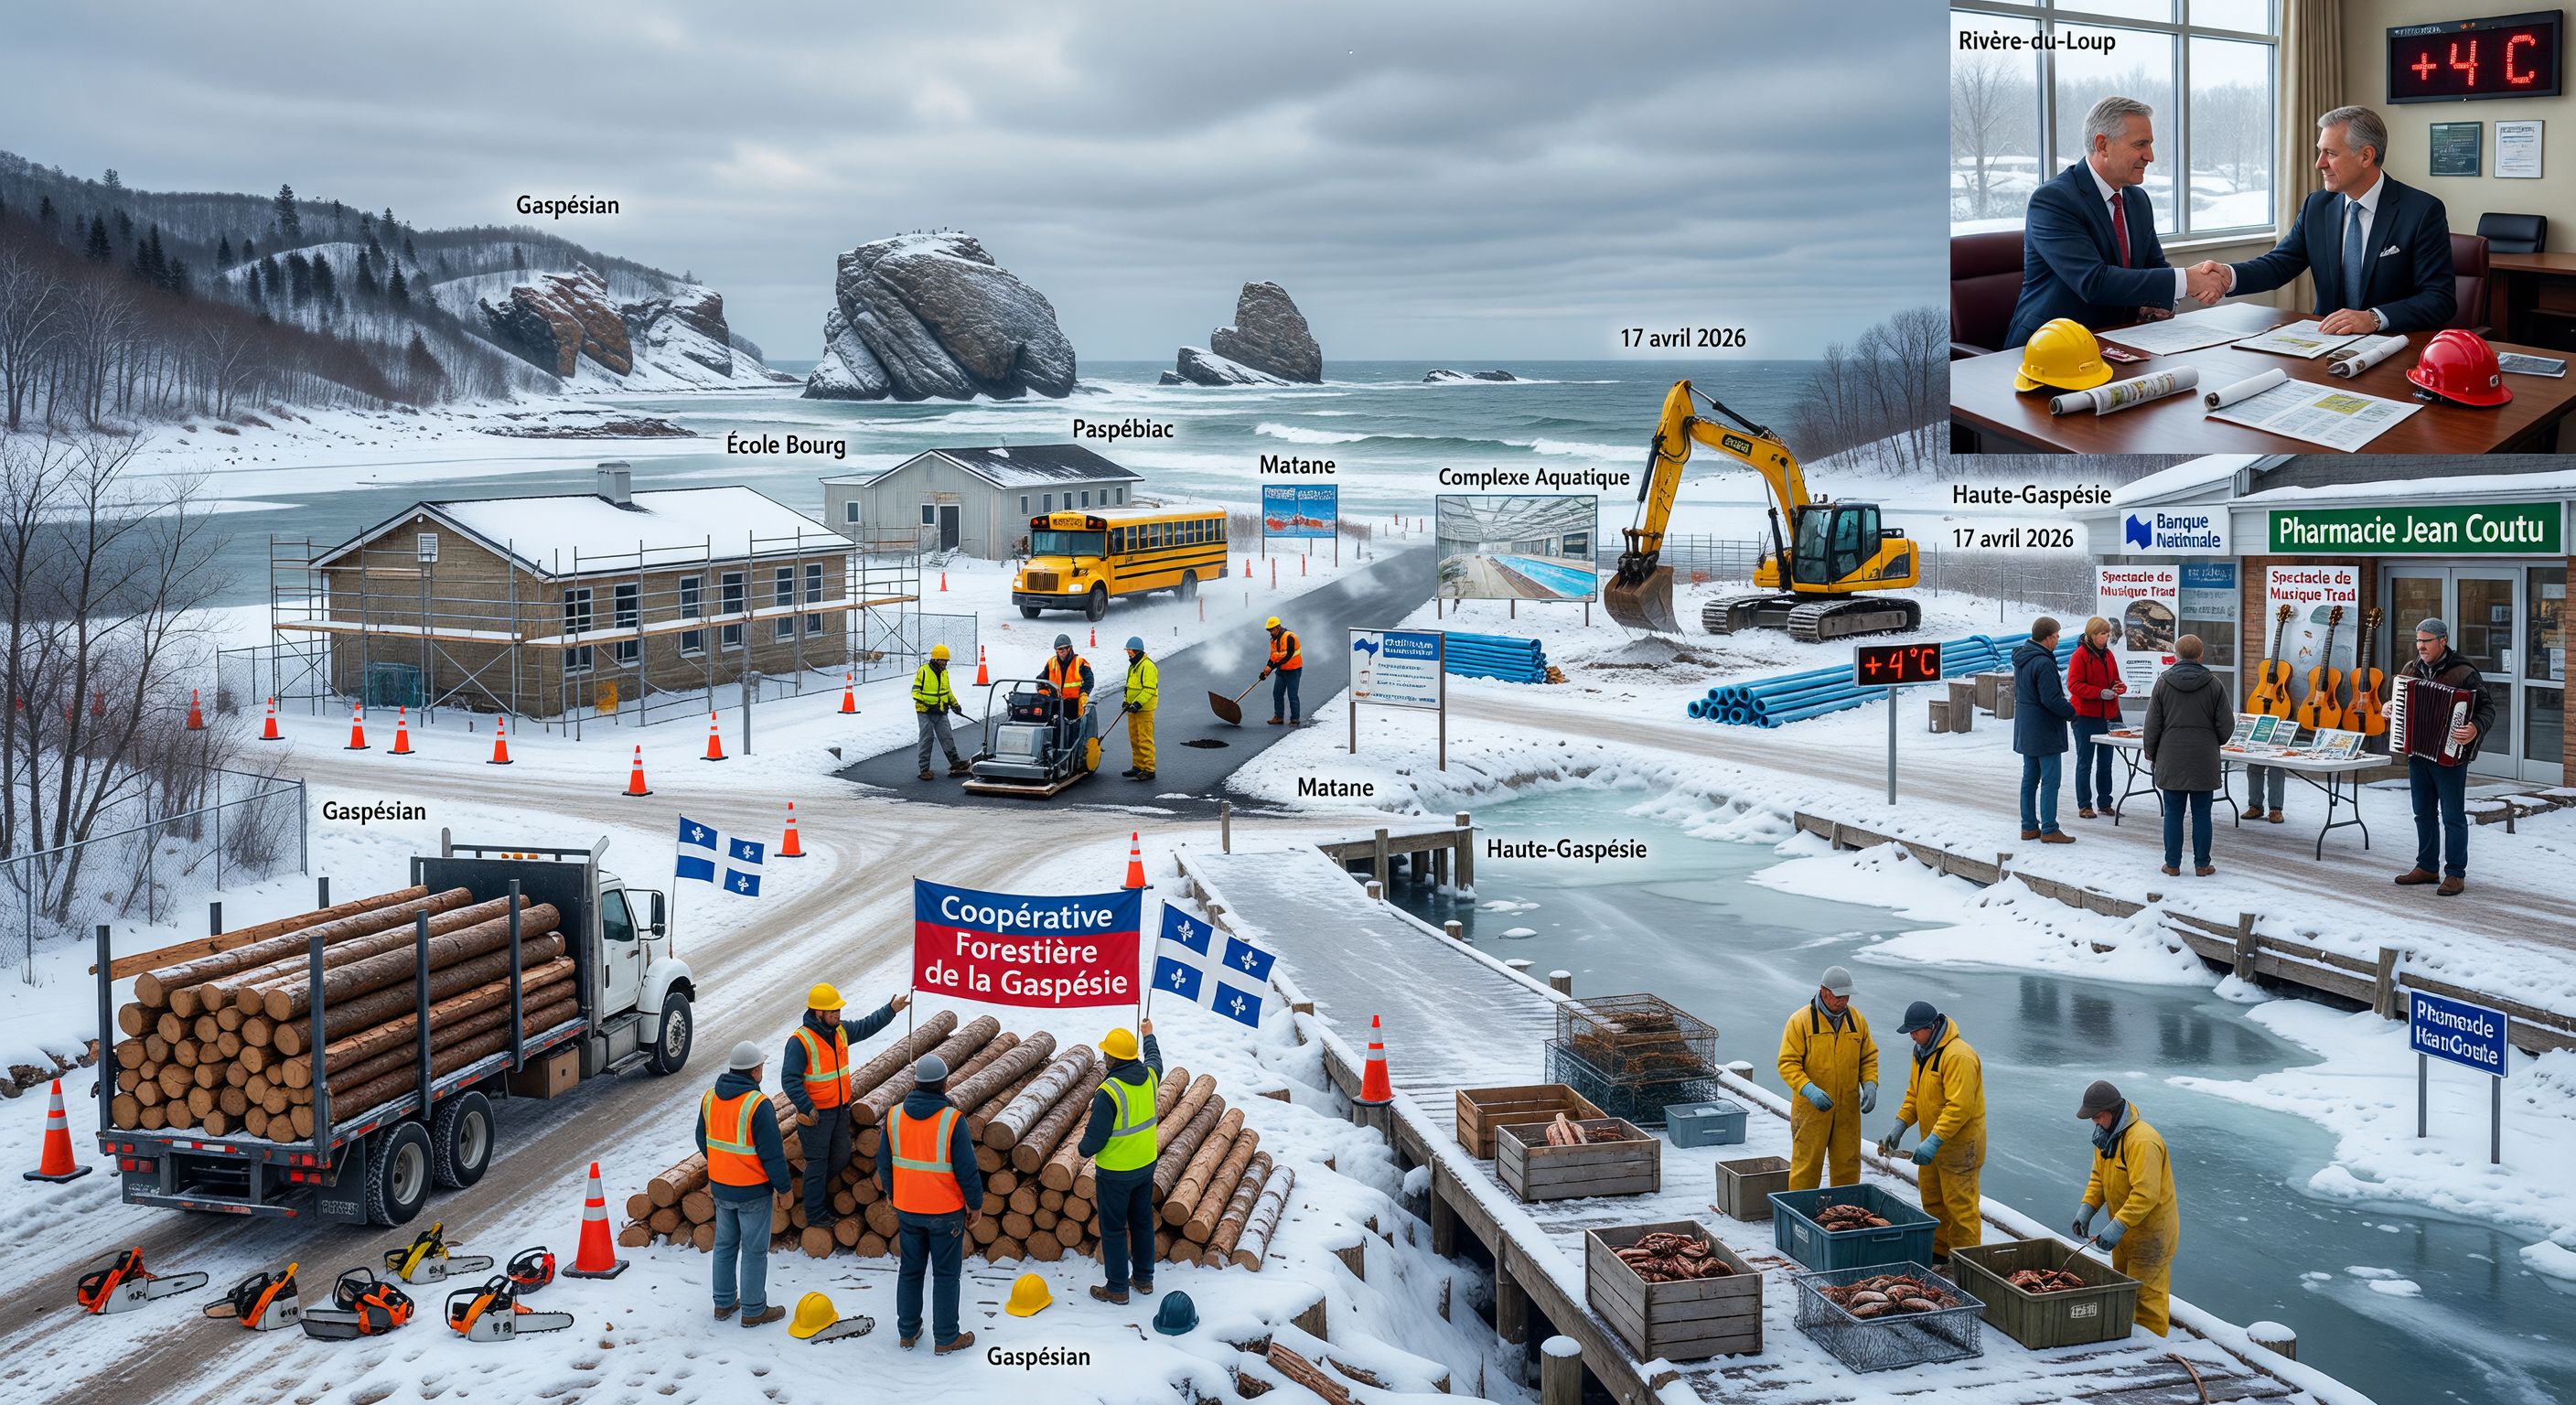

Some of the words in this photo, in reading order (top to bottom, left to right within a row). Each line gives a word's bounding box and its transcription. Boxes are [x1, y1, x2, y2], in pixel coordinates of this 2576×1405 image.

[2157, 513, 2208, 533] Banque
[2280, 516, 2396, 544] Pharmacie
[2402, 515, 2459, 544] Jean
[2465, 513, 2544, 544] Coutu
[2271, 570, 2331, 585] Spectacle
[2334, 570, 2351, 585] de
[2270, 586, 2322, 604] Musique
[2324, 587, 2356, 602] Trad
[1864, 648, 1935, 680] +4°C
[941, 896, 1113, 933] Coopérative
[956, 931, 1098, 964] Forestière
[925, 959, 959, 987] de
[968, 965, 991, 992] la
[1001, 970, 1128, 1003] Gaspésie
